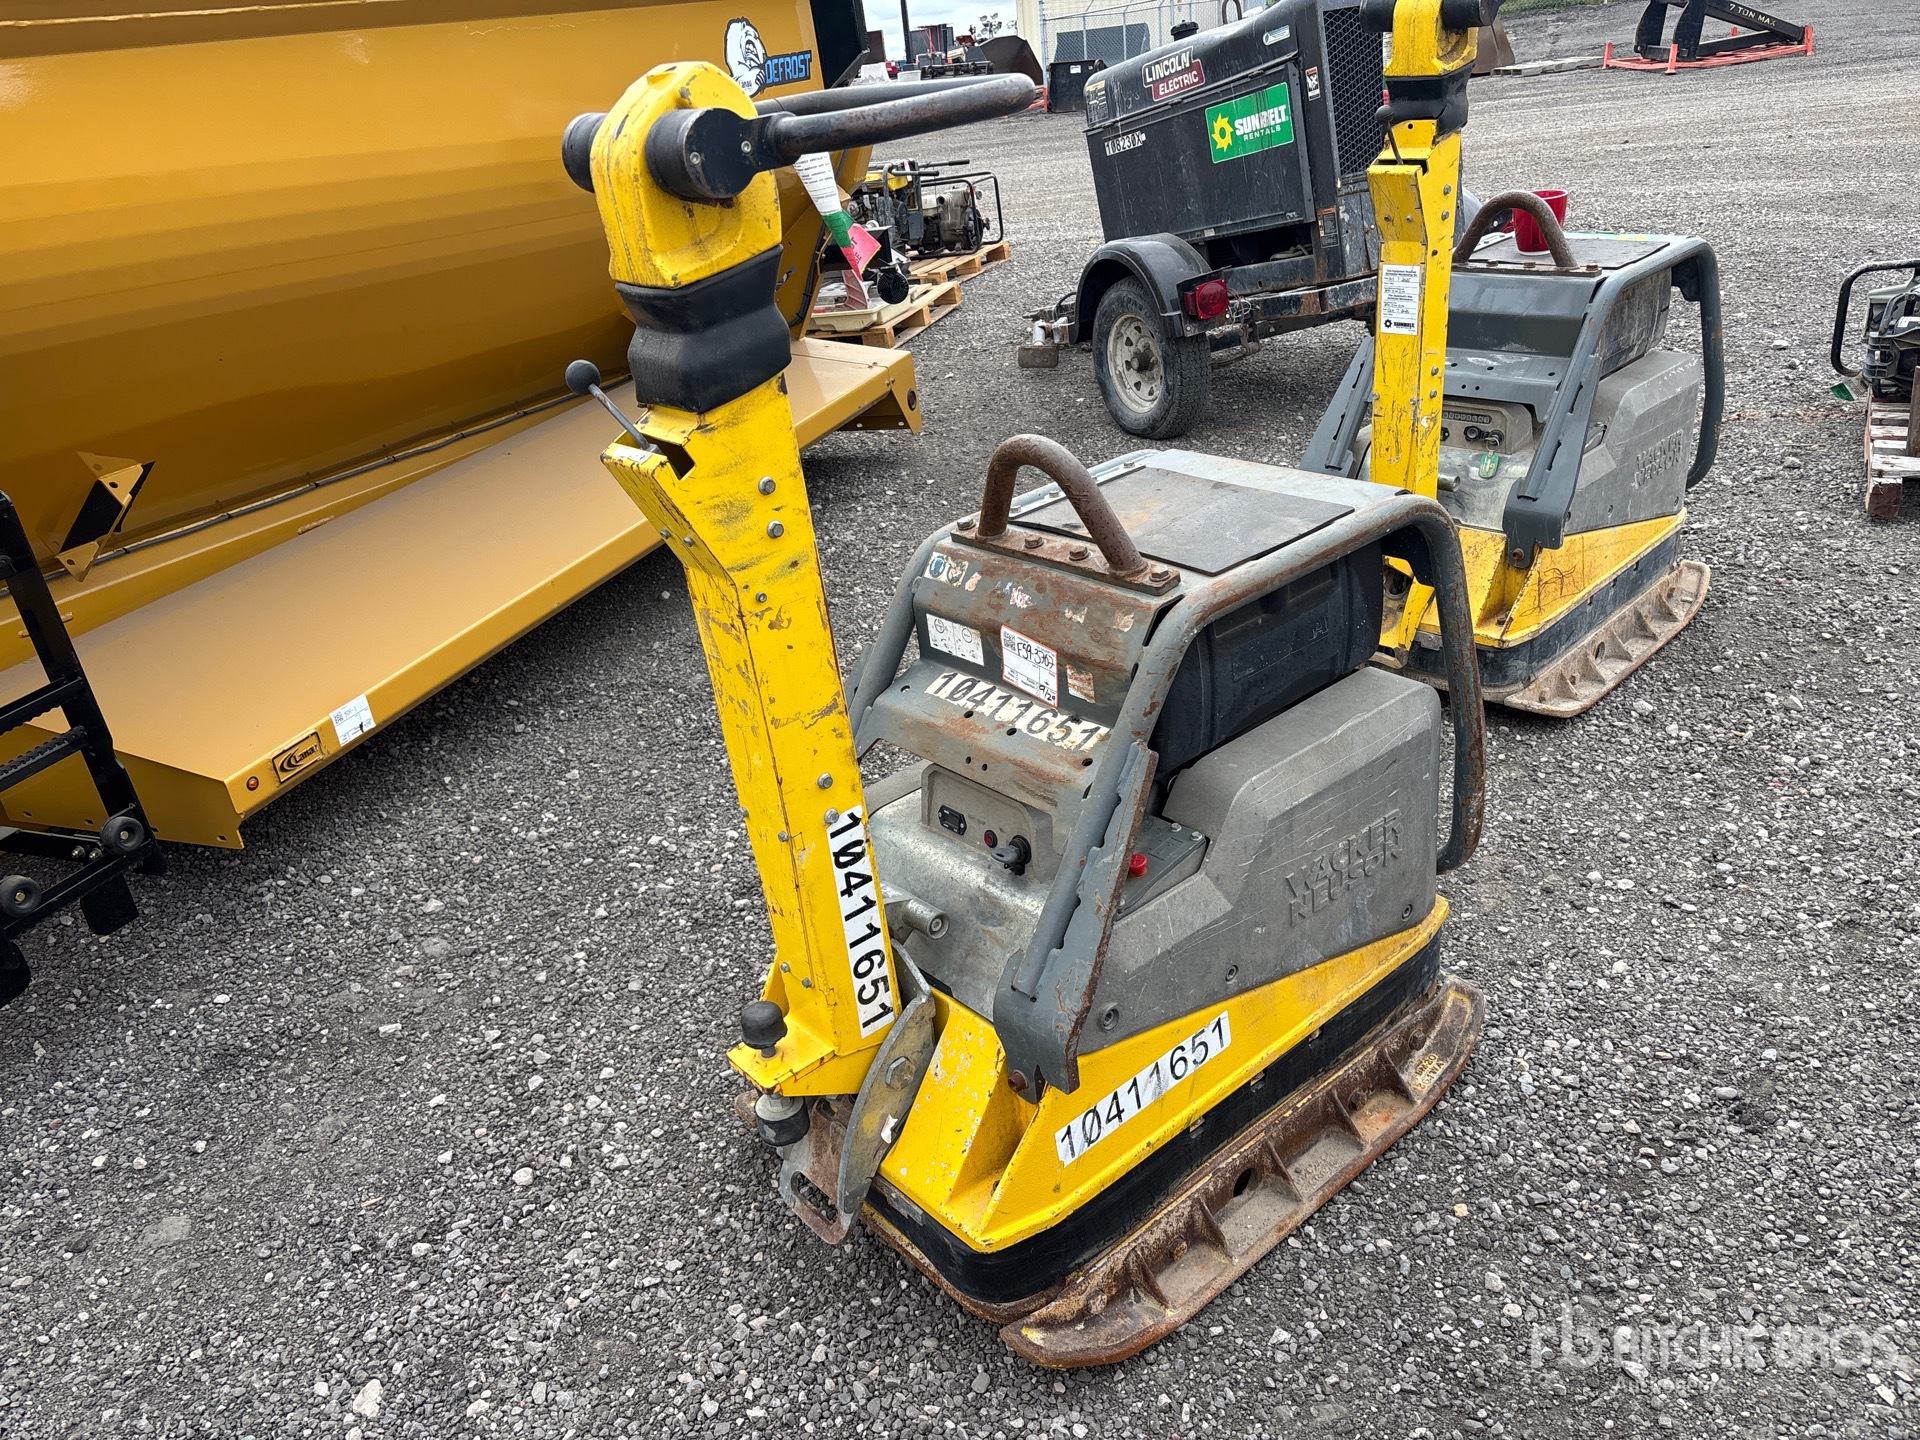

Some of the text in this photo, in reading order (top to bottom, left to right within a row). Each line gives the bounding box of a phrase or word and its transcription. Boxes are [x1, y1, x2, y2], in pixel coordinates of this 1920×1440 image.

[1738, 6, 1756, 18] TON
[1757, 14, 1777, 27] MAX
[764, 53, 811, 84] DEFROST
[1145, 51, 1191, 82] LINCOLN
[1159, 70, 1199, 95] ELECTRIC
[1234, 104, 1287, 136] SUNBELT
[1243, 125, 1281, 141] RENTALS
[1105, 132, 1143, 155] 108230X
[934, 672, 1102, 750] 10411651
[1285, 809, 1402, 897] WACKER
[1289, 841, 1400, 927] NEUSON
[830, 812, 894, 1029] 10411651
[1061, 1017, 1225, 1158] 10411651
